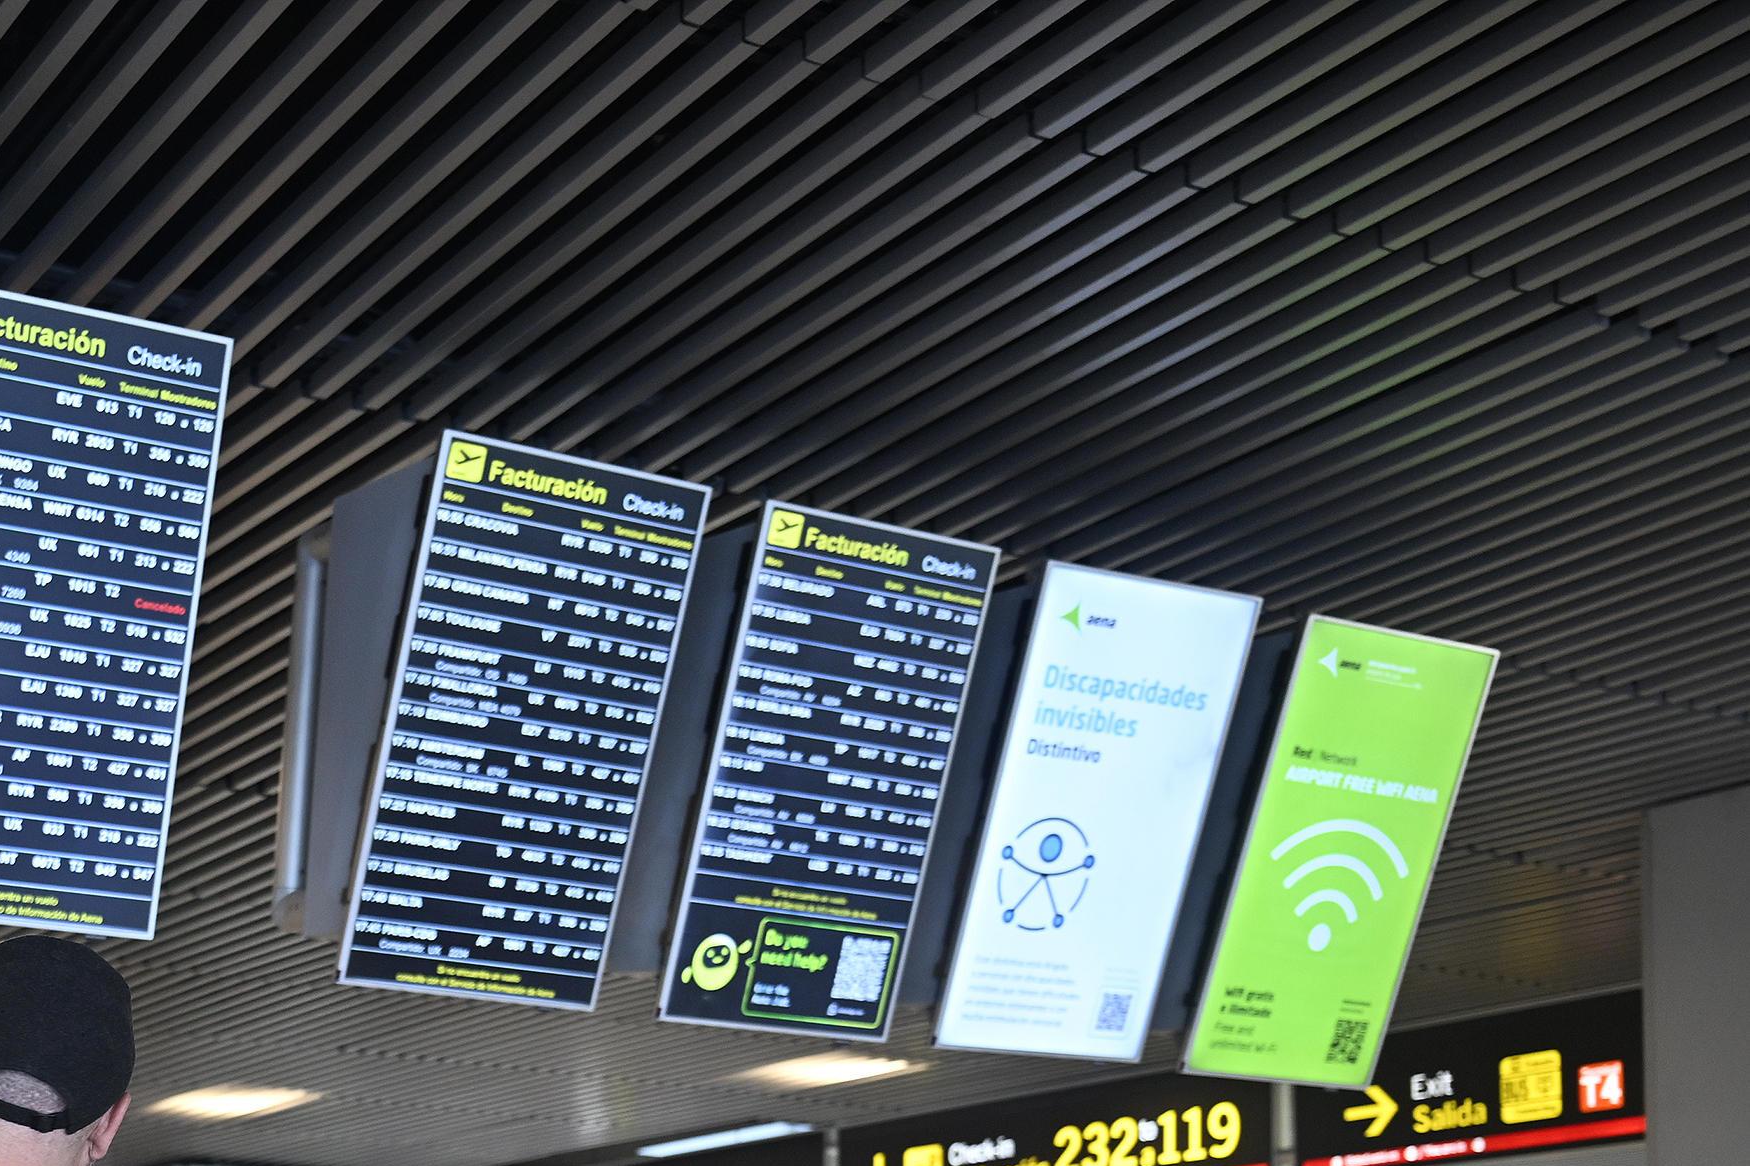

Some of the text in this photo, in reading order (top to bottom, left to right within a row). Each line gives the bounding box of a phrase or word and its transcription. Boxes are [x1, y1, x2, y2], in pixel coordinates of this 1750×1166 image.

[127, 345, 202, 377] Check-in
[489, 461, 607, 504] Facturación
[805, 528, 909, 568] Facturación
[1043, 664, 1208, 712] Discapacidades
[1034, 701, 1138, 737] invisibles
[1026, 738, 1101, 764] Distintivo
[1409, 1070, 1454, 1100] Exit
[1579, 1071, 1623, 1108] T4
[1157, 1101, 1241, 1166] 119
[1412, 1098, 1488, 1133] Salida
